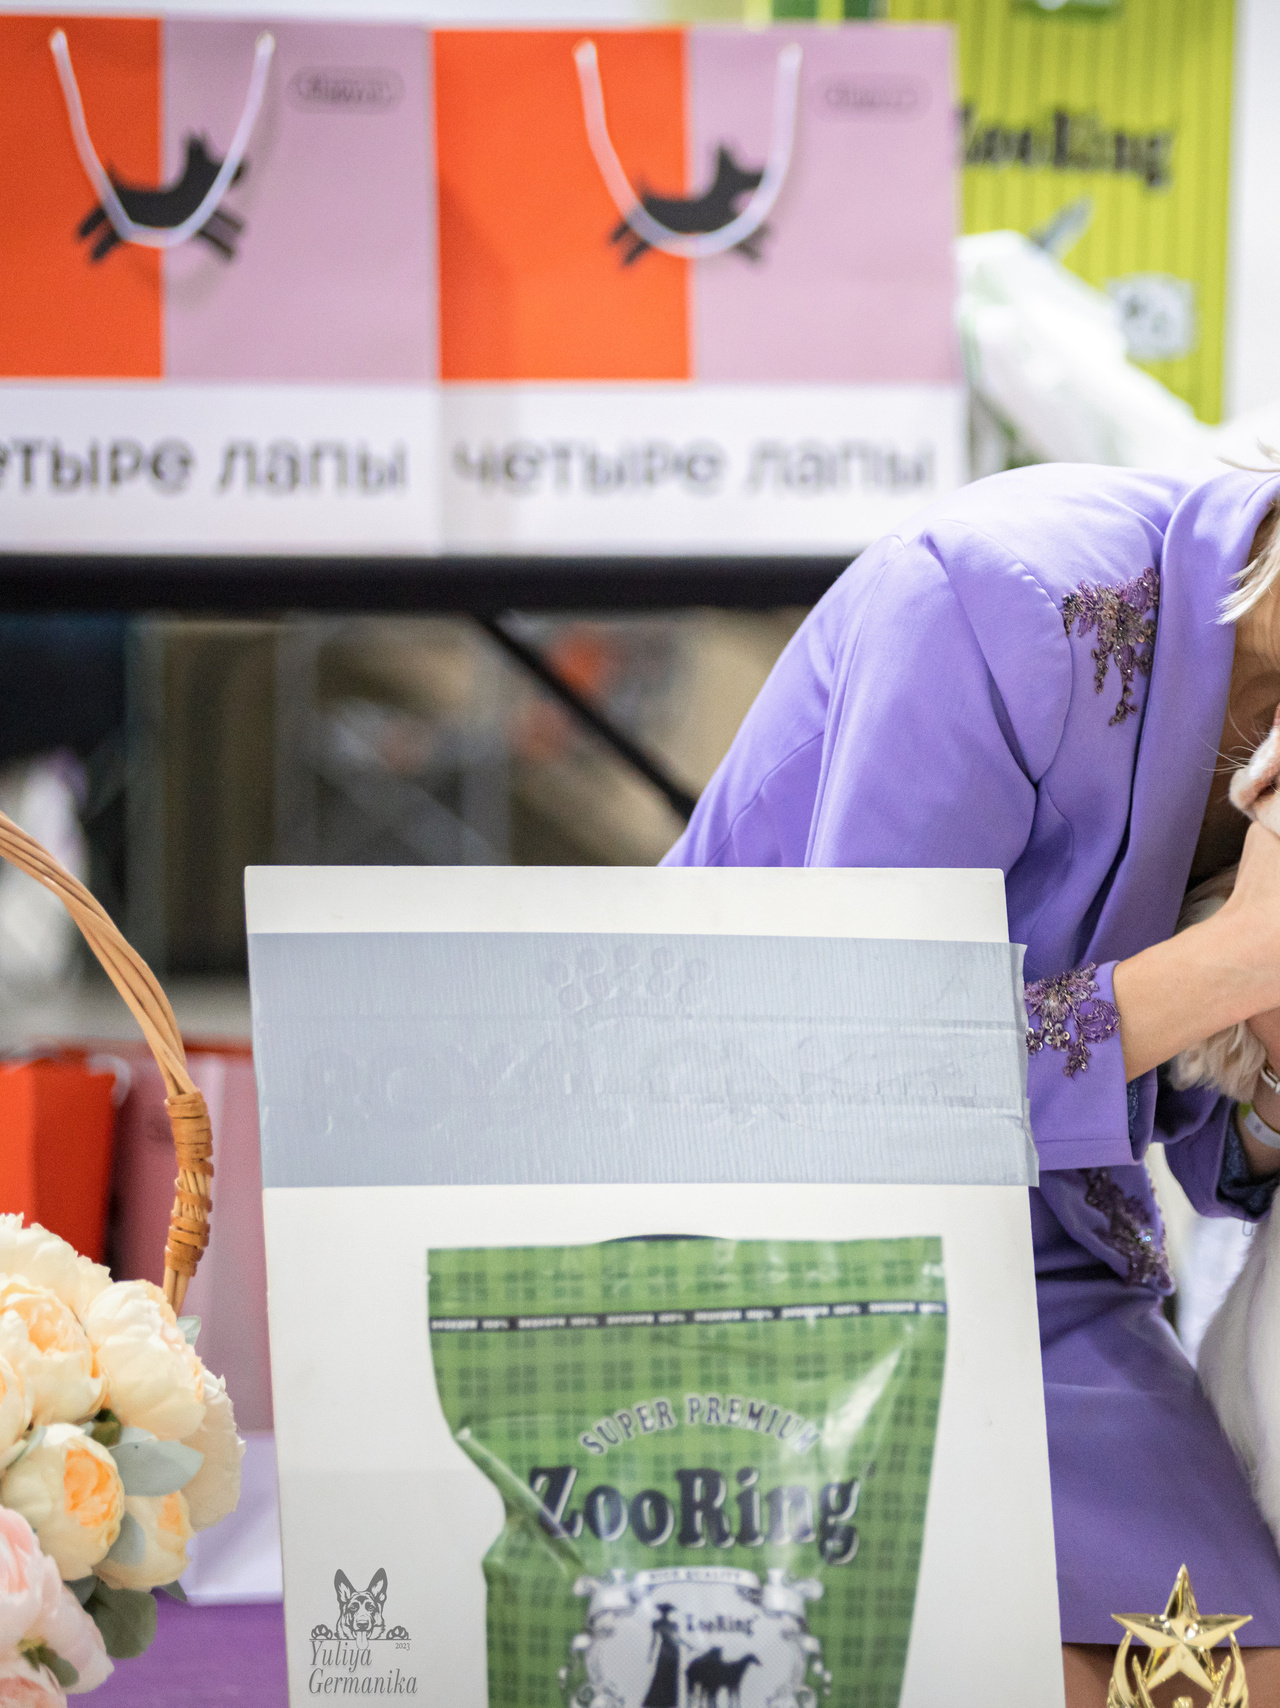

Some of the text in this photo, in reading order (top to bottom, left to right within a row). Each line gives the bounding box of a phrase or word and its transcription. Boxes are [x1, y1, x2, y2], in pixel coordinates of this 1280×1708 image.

[0, 438, 409, 495] тыре лапы
[452, 437, 938, 495] четыре лапы
[580, 1393, 822, 1456] SUPER PREMIUM
[528, 1463, 862, 1566] ZooRing
